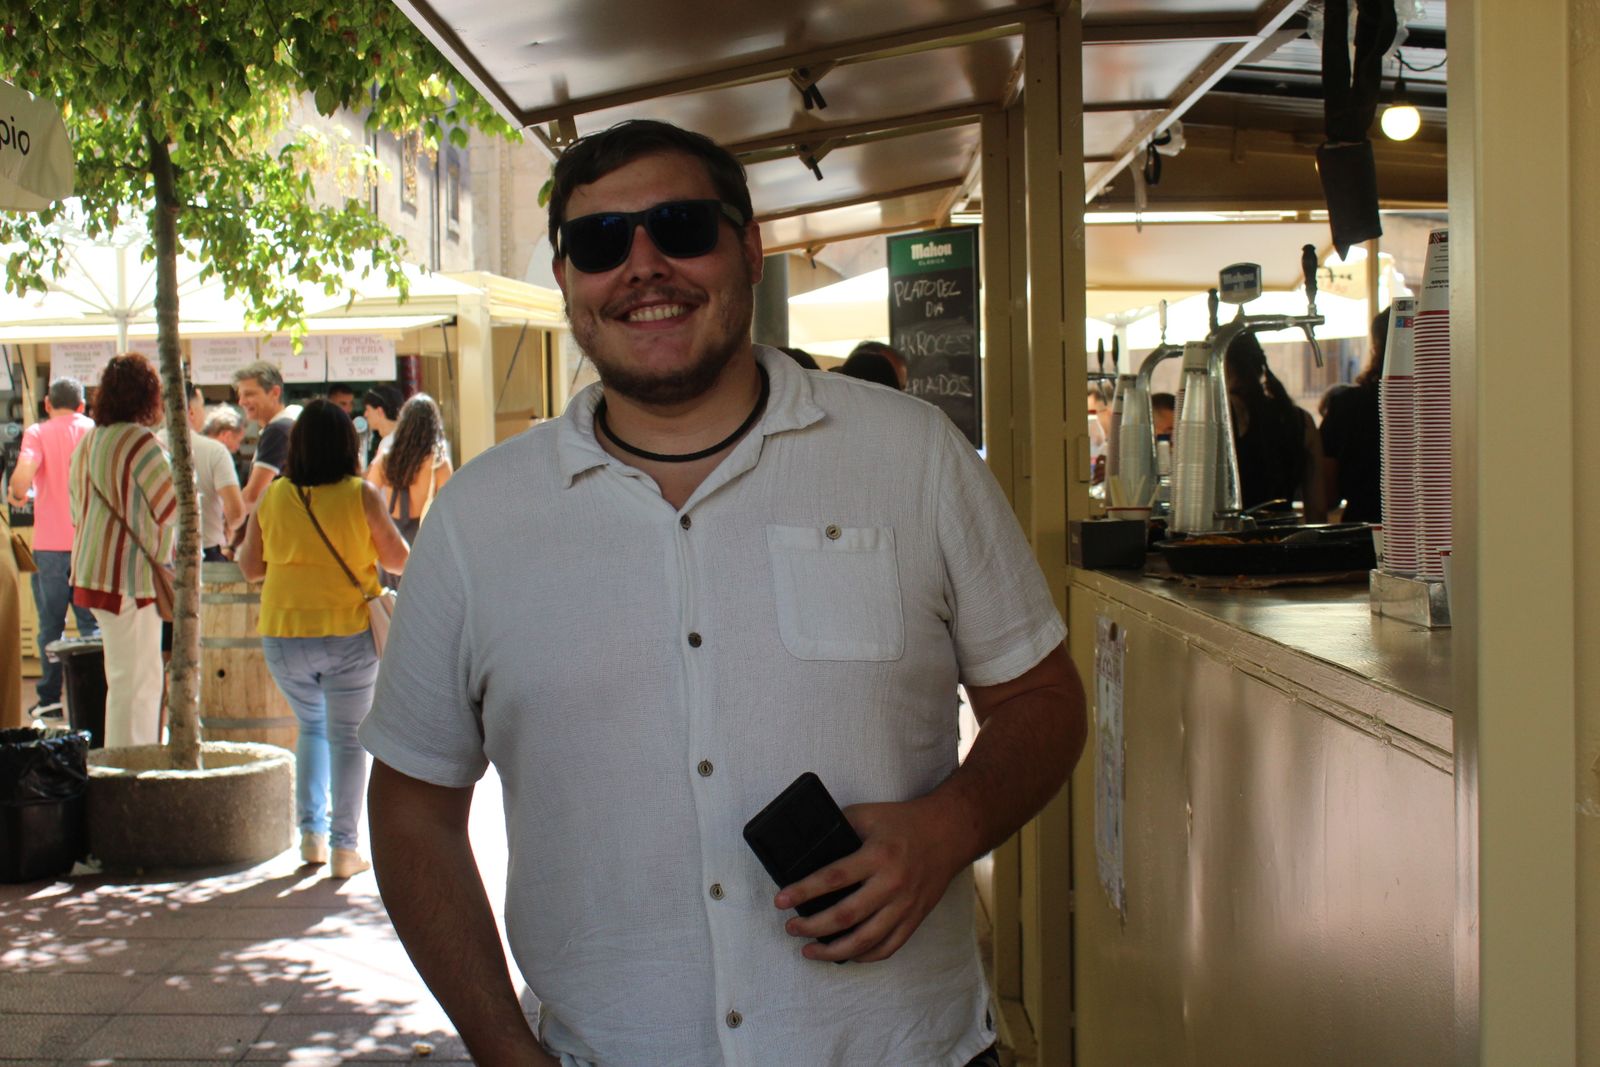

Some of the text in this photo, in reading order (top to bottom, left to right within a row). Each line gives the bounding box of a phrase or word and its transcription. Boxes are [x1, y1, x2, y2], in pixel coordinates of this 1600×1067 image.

[911, 242, 952, 260] Mahou
[893, 278, 962, 308] PLATO DEL
